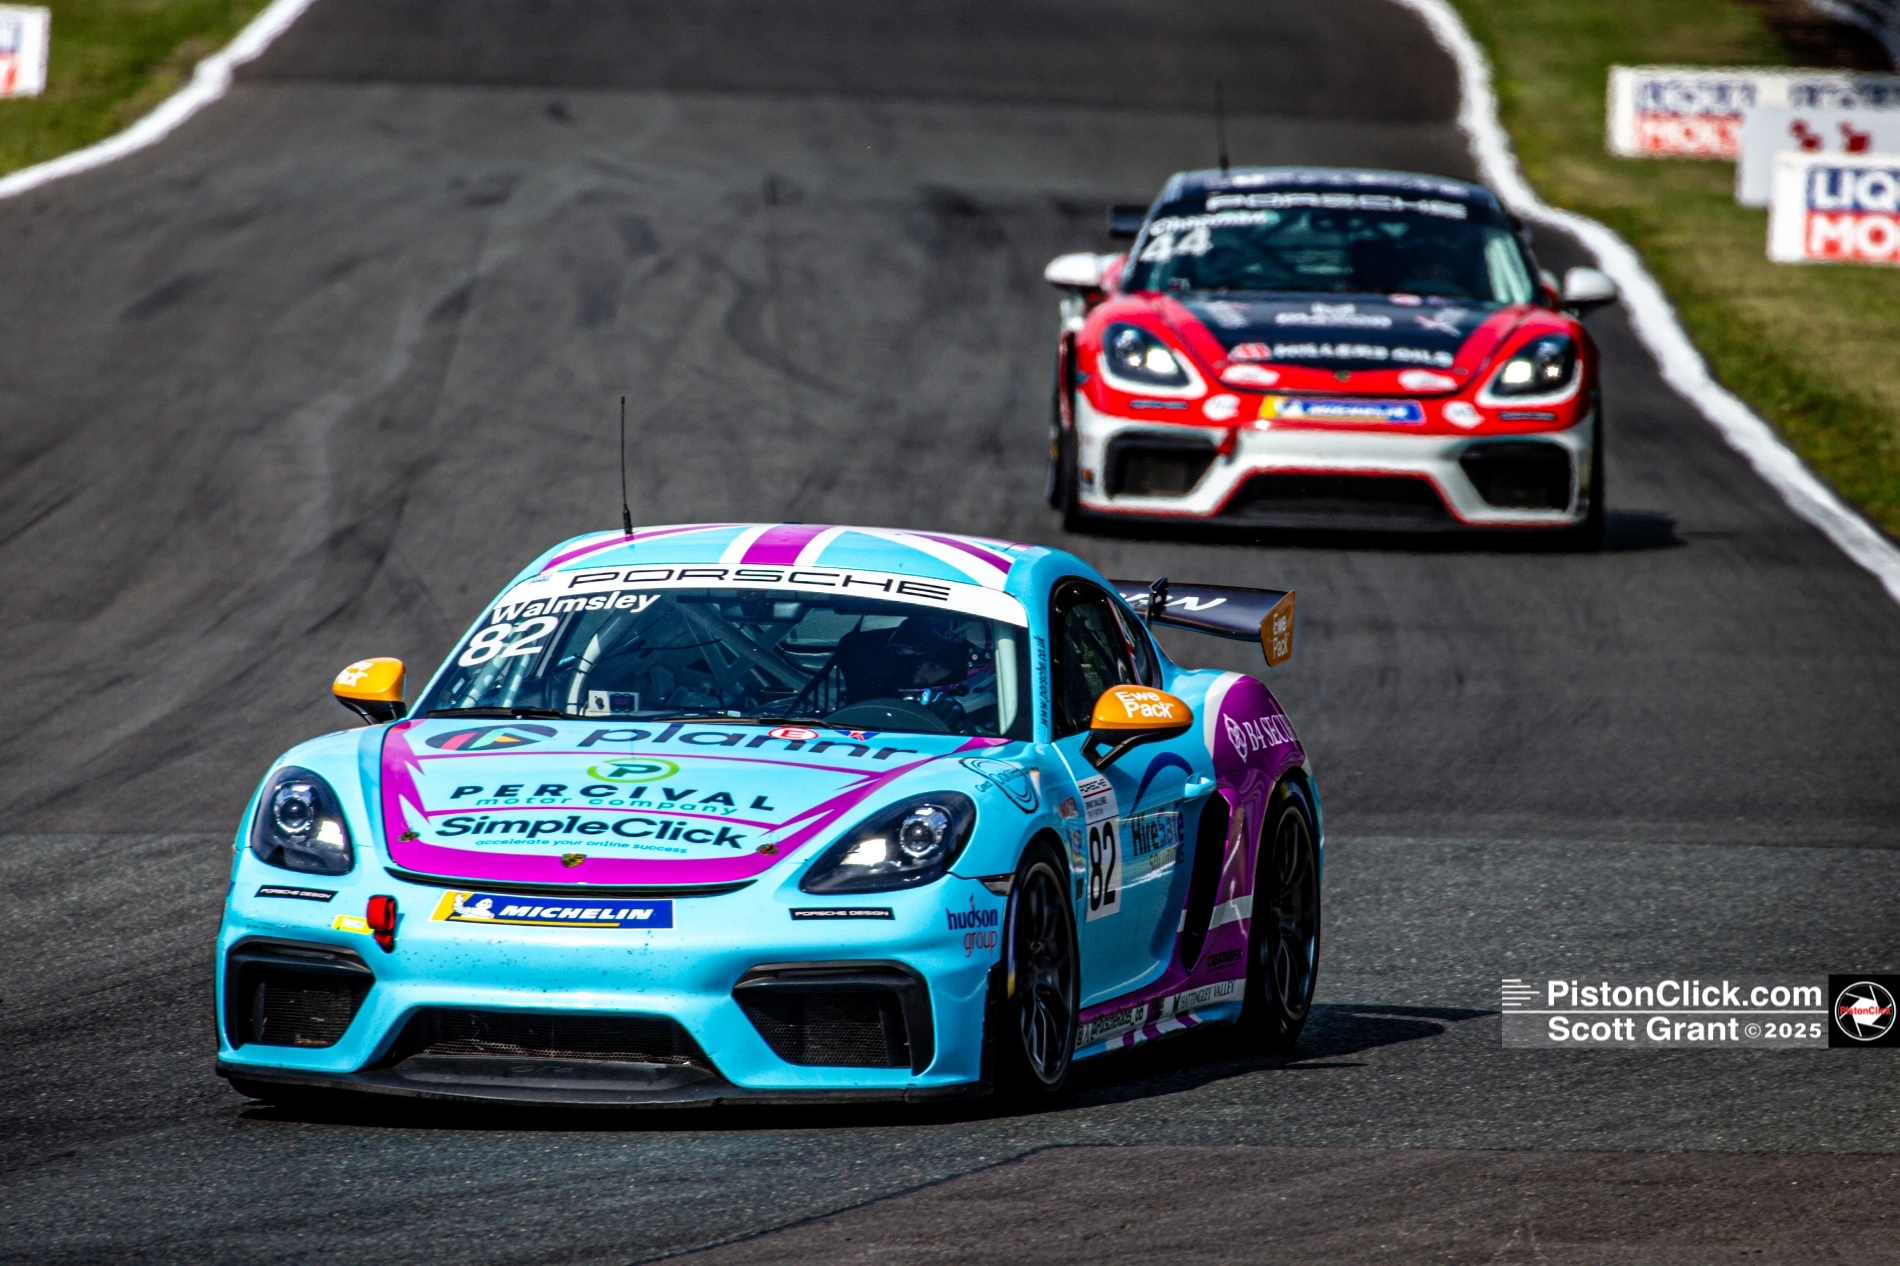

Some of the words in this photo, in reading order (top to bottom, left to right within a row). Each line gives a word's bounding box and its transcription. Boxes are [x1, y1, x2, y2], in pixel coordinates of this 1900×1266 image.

[1206, 193, 1467, 219] PORSCHE
[1140, 226, 1214, 263] 44
[568, 567, 951, 602] PORSCHE
[491, 591, 662, 625] Walmsley
[1272, 612, 1287, 636] Ewe
[459, 616, 560, 668] 82
[1272, 637, 1289, 660] Pack
[1114, 691, 1160, 704] Ewe
[1123, 701, 1175, 719] Pack
[577, 723, 919, 760] plannr
[449, 784, 775, 811] PERCIVAL
[476, 797, 573, 807] motor
[589, 799, 739, 816] company
[435, 815, 748, 850] SimpleClick
[475, 839, 551, 847] accelerate
[586, 840, 629, 849] online
[632, 844, 688, 855] success
[1088, 821, 1117, 911] 82
[502, 904, 655, 921] MICHELIN
[946, 898, 999, 931] hudson
[963, 930, 998, 957] group
